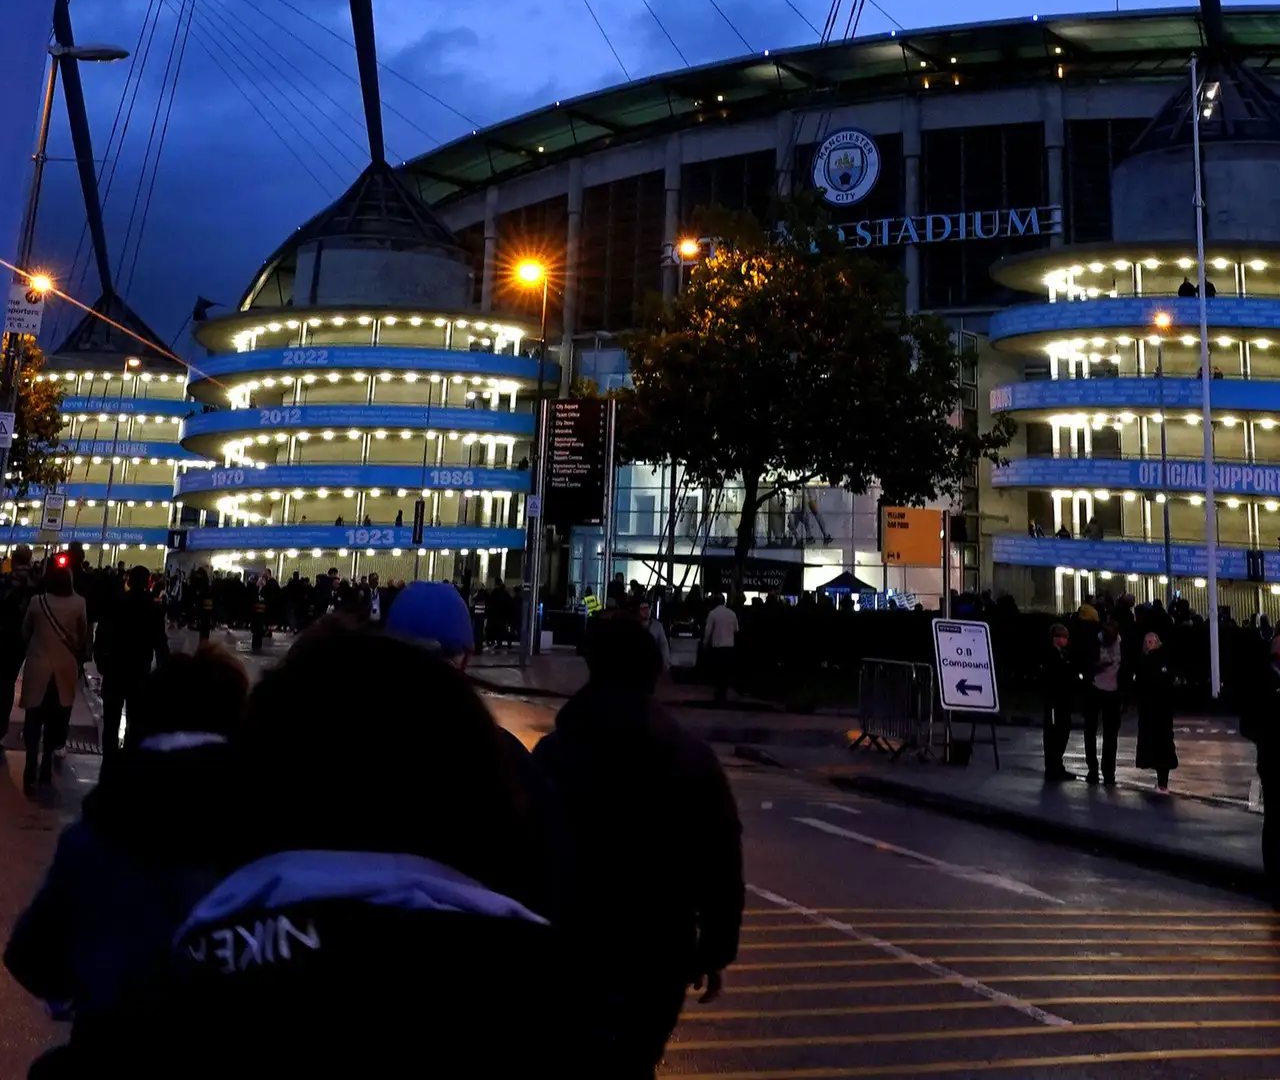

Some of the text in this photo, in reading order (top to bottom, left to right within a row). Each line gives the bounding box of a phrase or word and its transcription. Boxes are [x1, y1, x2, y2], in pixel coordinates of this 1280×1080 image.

[817, 132, 875, 160] MANCHESTER
[835, 192, 856, 202] CITY
[855, 207, 1041, 249] STADIUM
[282, 351, 328, 366] 2022
[260, 408, 302, 425] 2012
[211, 470, 245, 486] 1970
[430, 470, 474, 486] 1986
[345, 528, 395, 546] 1923
[942, 658, 989, 670] Compound
[210, 914, 320, 975] NIKE
